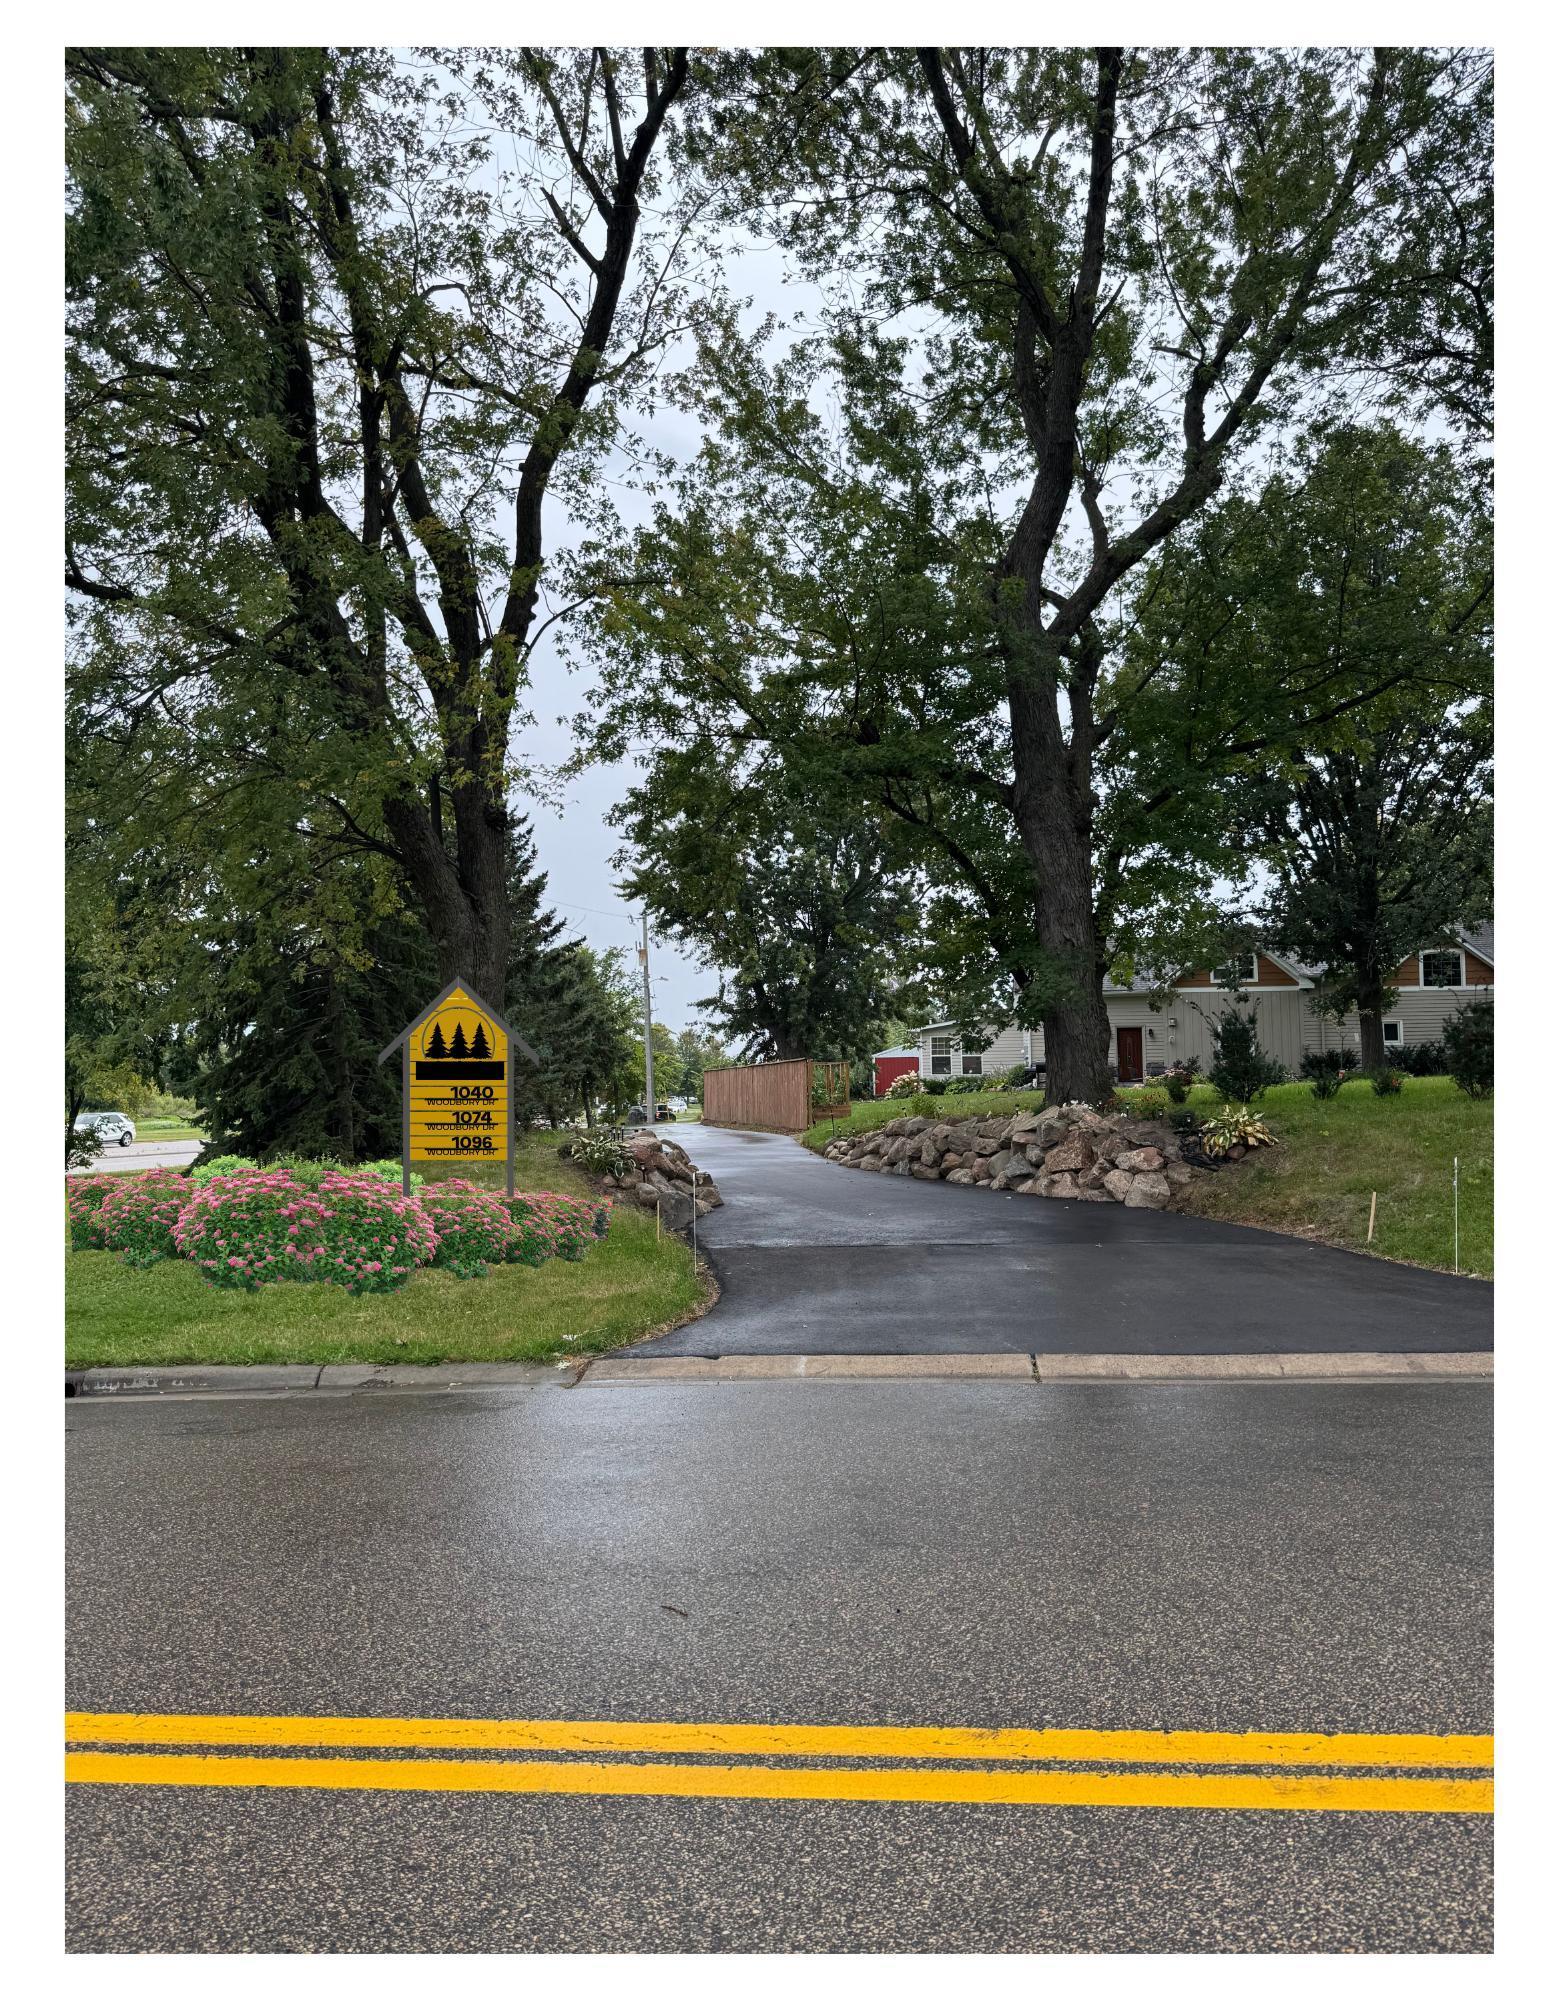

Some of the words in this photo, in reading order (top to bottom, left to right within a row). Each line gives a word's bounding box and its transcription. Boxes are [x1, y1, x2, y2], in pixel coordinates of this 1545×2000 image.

[450, 1086, 494, 1099] 1040
[452, 1111, 492, 1124] 1074
[452, 1136, 493, 1149] 1096
